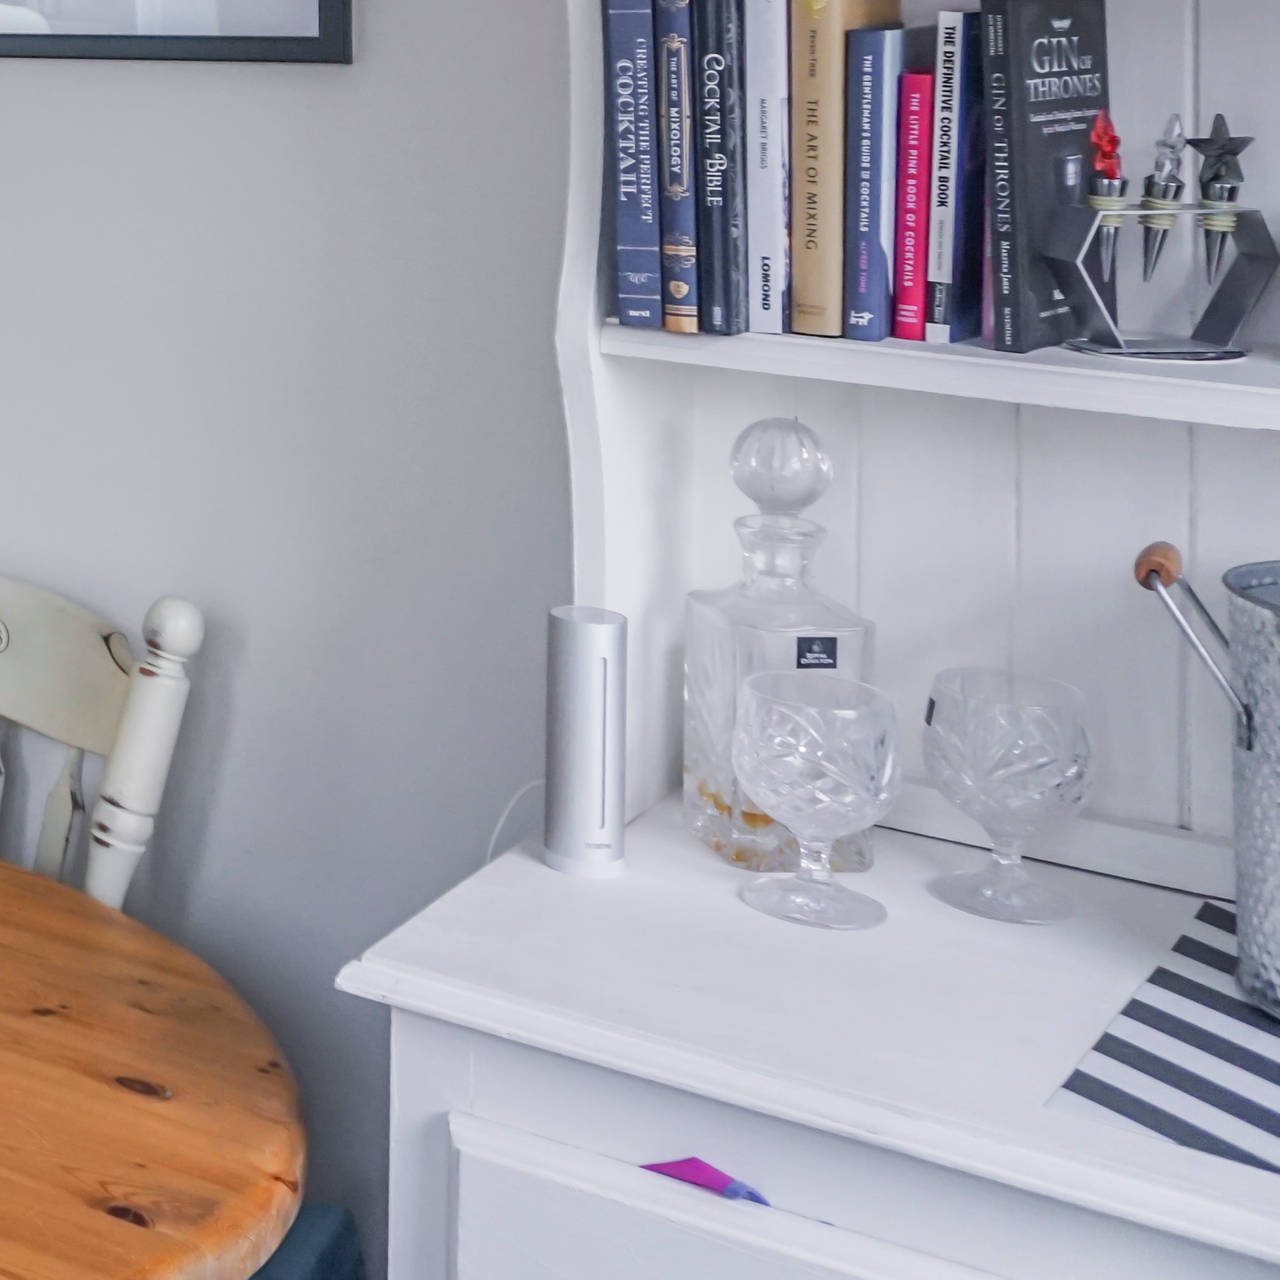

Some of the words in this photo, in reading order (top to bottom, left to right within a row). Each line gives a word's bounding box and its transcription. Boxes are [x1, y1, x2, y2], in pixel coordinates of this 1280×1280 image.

[943, 25, 957, 47] THE
[668, 56, 678, 72] THE
[863, 54, 874, 73] THE
[1031, 35, 1080, 74] GIN
[635, 38, 649, 116] CREATING
[670, 74, 679, 89] ART
[941, 50, 955, 113] DEFINITIVE
[991, 72, 1007, 110] GIN
[1025, 73, 1102, 102] THRONES
[670, 90, 679, 101] OF
[703, 53, 726, 149] COCKTAIL
[909, 93, 920, 111] THE
[616, 58, 638, 201] COCKTAIL
[759, 97, 769, 139] MARGARET
[805, 100, 819, 126] THE
[637, 119, 651, 151] THE
[669, 107, 682, 173] MIXOLOGY
[805, 132, 819, 160] ART
[907, 115, 920, 146] LITTLE
[938, 116, 953, 172] COCKTAIL
[759, 141, 769, 170] BRIGGS
[860, 139, 872, 169] GUIDE
[906, 149, 919, 175] PINK
[639, 154, 653, 223] PERFECT
[705, 152, 728, 207] BIBLE
[805, 166, 819, 185] OF
[935, 175, 950, 209] BOOK
[994, 138, 1012, 233] THRONES
[859, 181, 871, 232] COCKTAILS
[905, 179, 917, 209] BOOK
[804, 191, 819, 251] MIXING
[905, 213, 917, 228] OF
[903, 231, 916, 288] COCKTAILS
[760, 256, 772, 311] LOMOND
